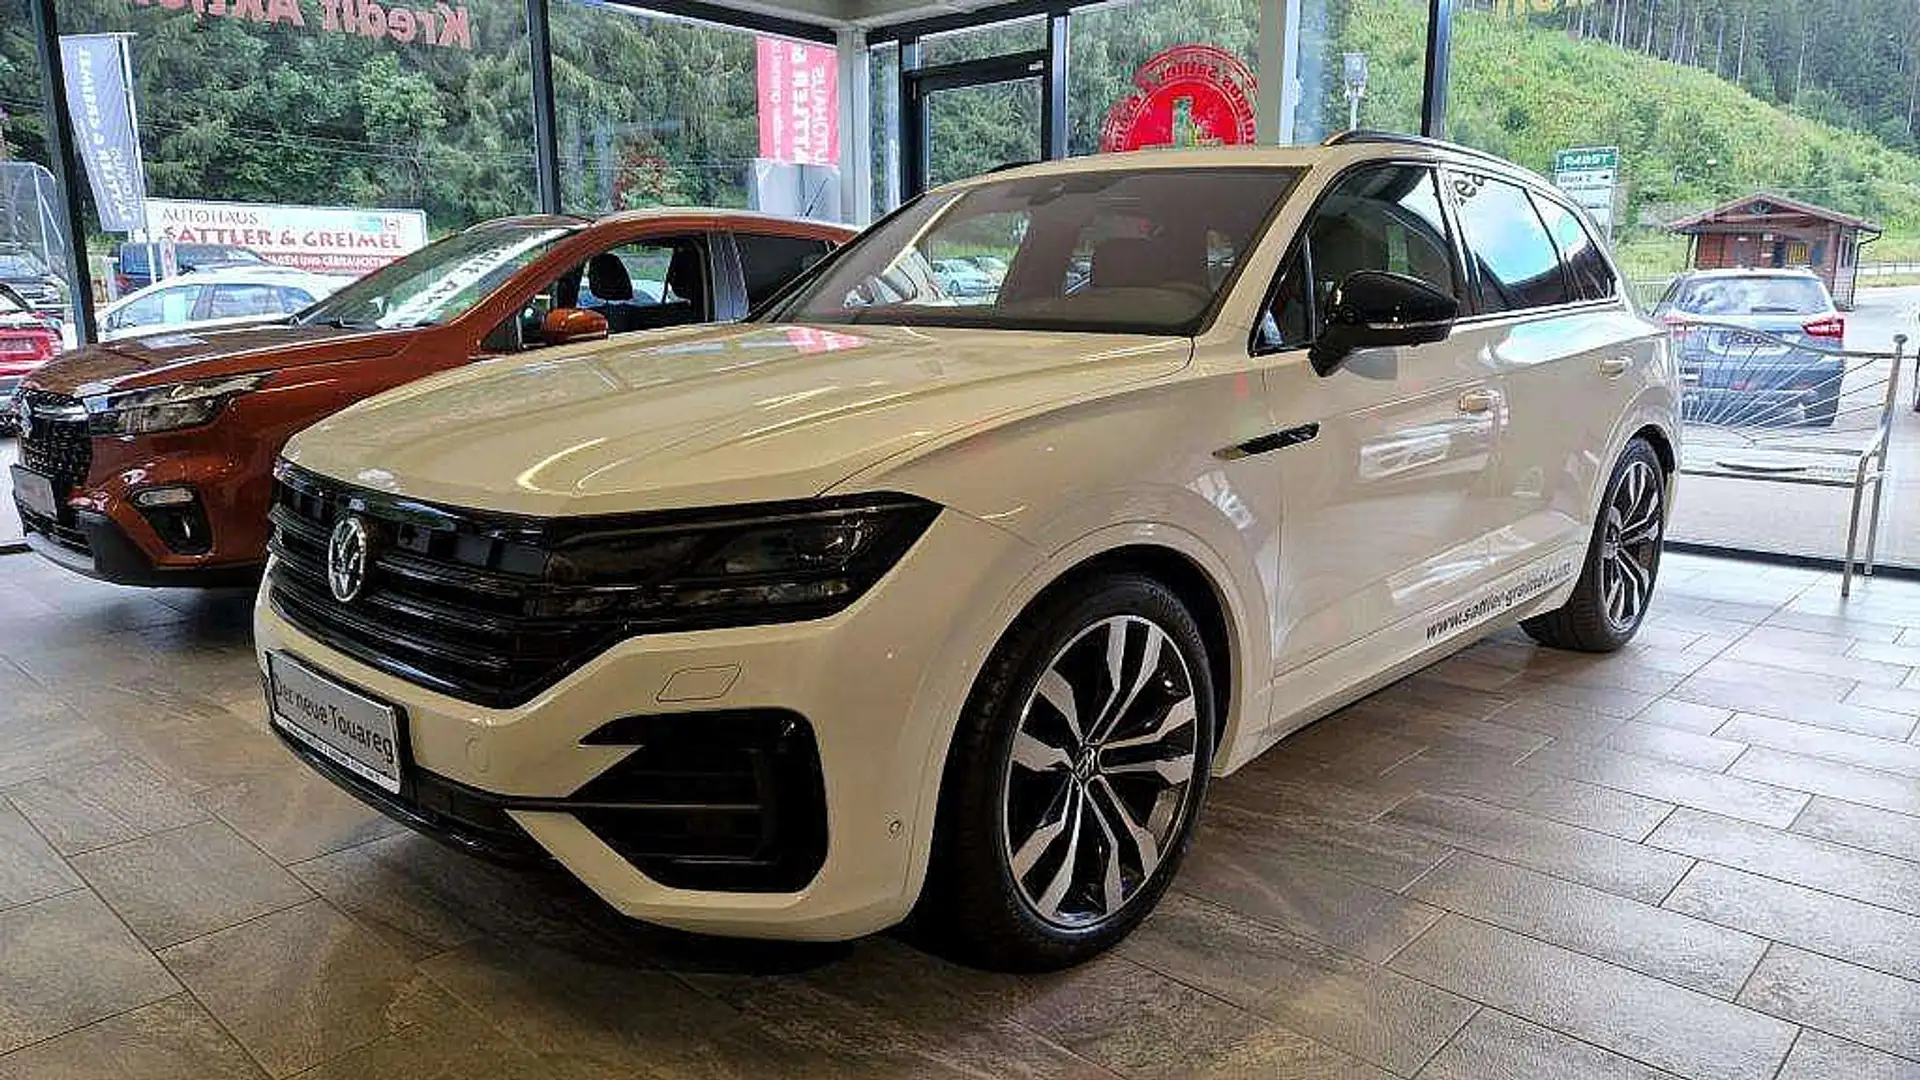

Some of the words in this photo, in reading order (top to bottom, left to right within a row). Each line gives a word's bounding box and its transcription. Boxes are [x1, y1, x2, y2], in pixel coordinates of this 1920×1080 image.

[163, 208, 259, 225] AUTOHAUS
[163, 224, 274, 246] SATTLER
[280, 229, 297, 246] &
[302, 231, 402, 248] GREIMEL
[296, 692, 328, 725] neue
[328, 704, 396, 764] Touareg
